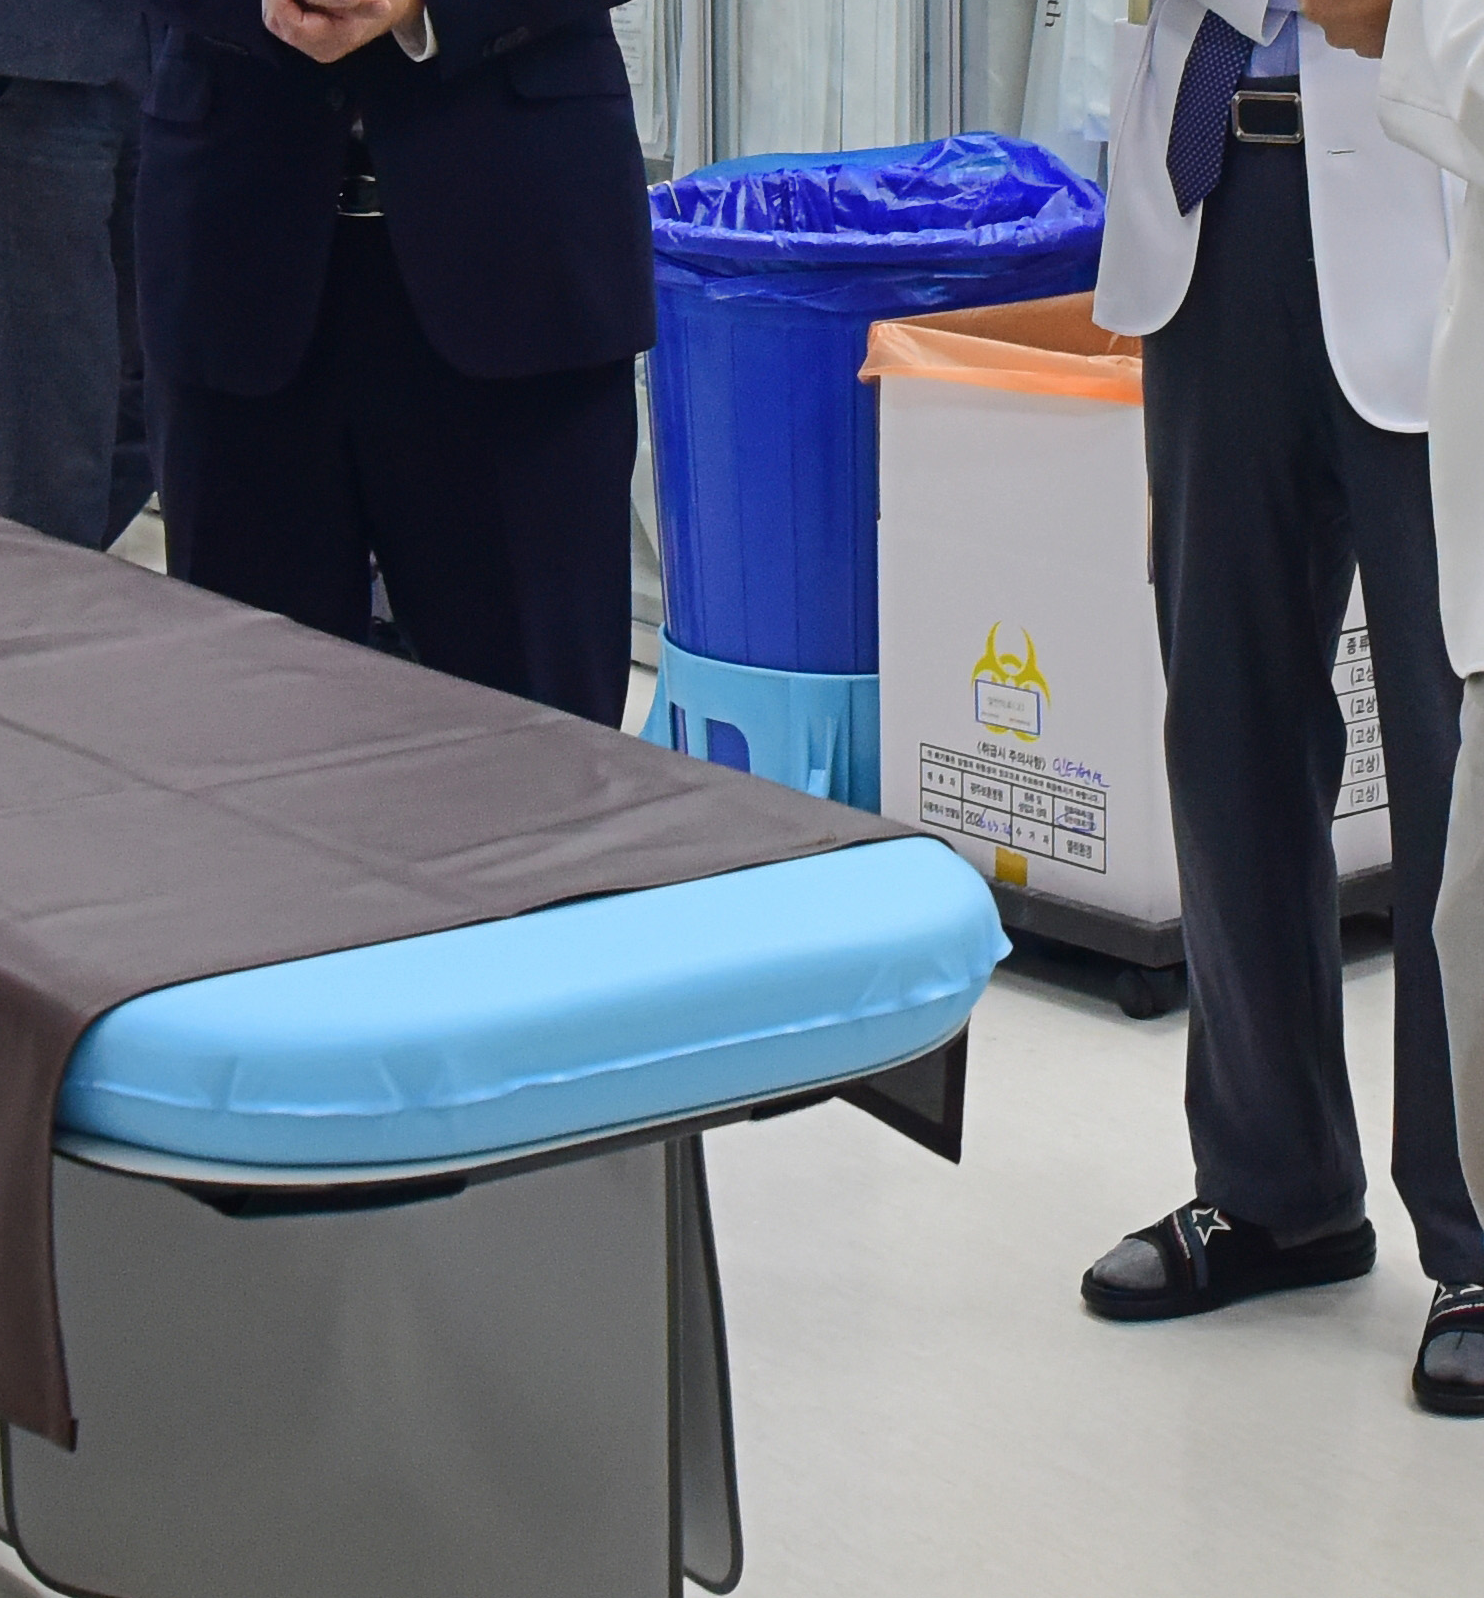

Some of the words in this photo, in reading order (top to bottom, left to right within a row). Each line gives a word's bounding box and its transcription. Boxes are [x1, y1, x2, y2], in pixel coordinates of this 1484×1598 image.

[1350, 724, 1381, 745] (고상)
[1350, 753, 1380, 779] (고상)
[1350, 783, 1380, 808] (고상)
